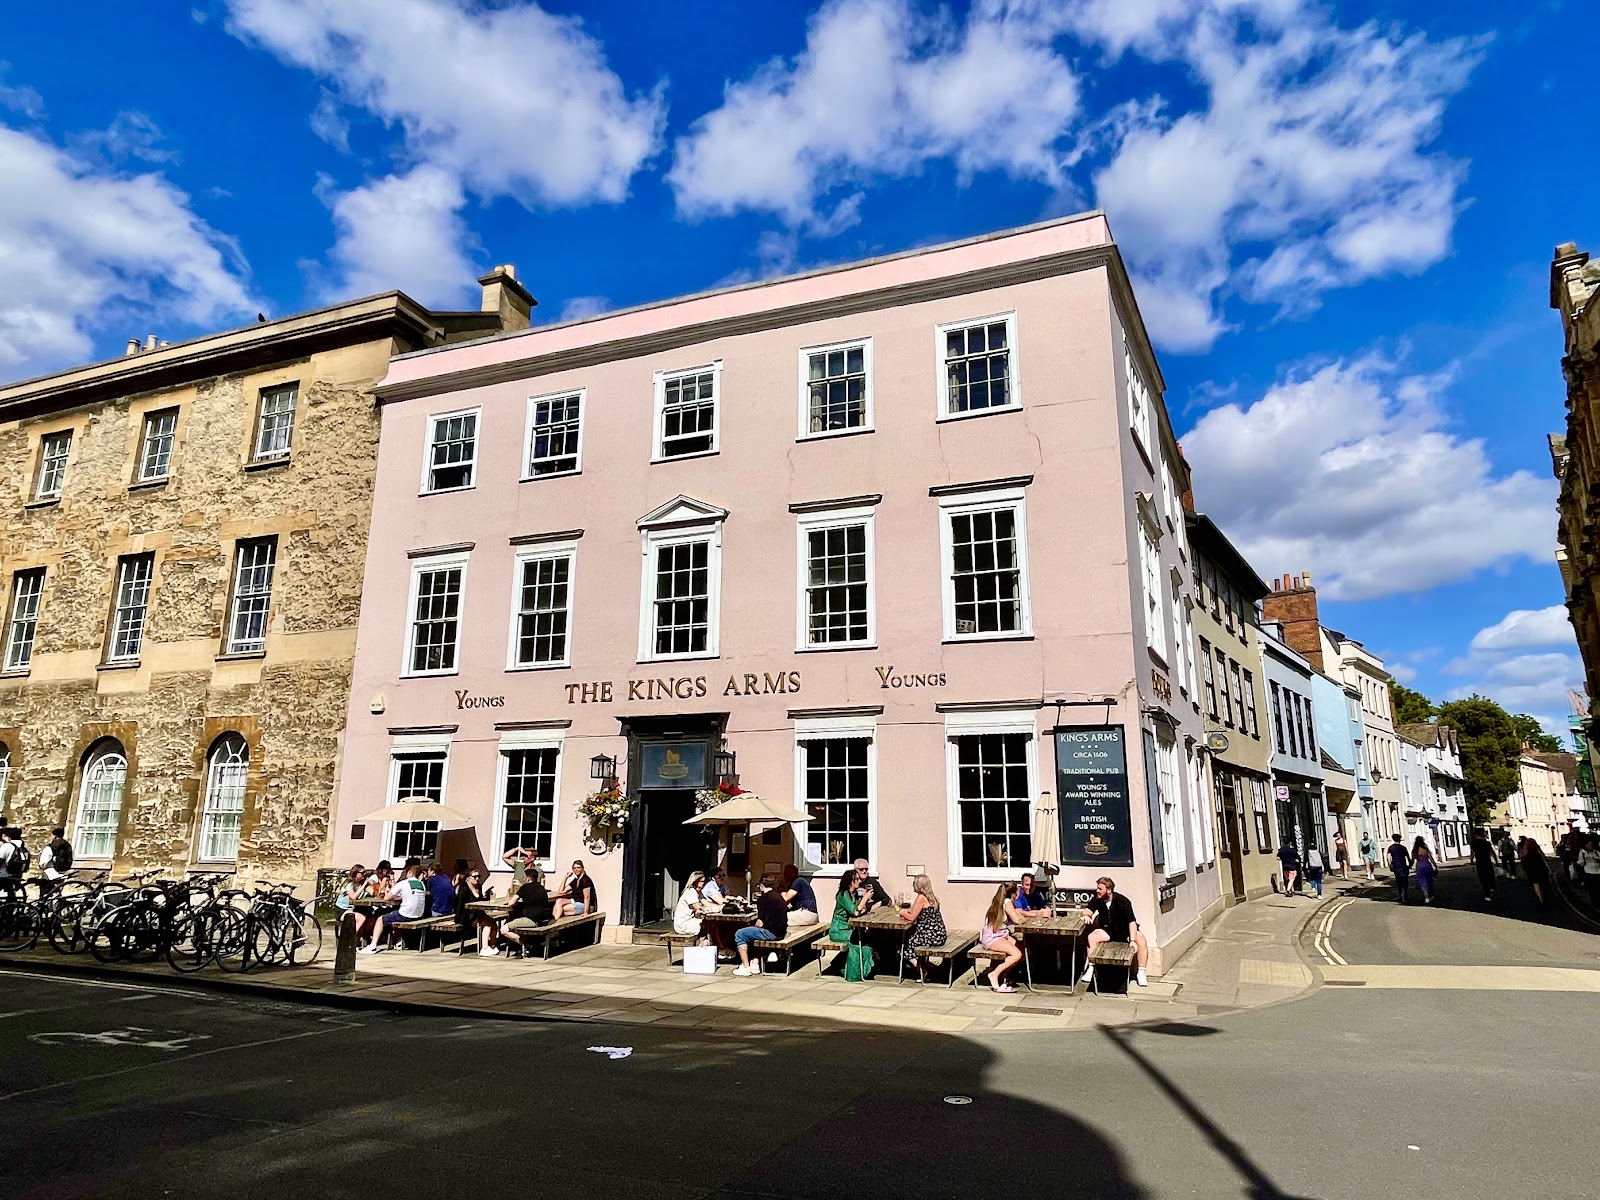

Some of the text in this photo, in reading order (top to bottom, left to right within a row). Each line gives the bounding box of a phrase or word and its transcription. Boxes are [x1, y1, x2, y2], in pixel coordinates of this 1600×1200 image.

[564, 671, 801, 704] THE KINGS ARMS
[1091, 733, 1119, 742] ARMS
[1090, 791, 1121, 799] WINNING
[1080, 815, 1107, 823] BRITISH
